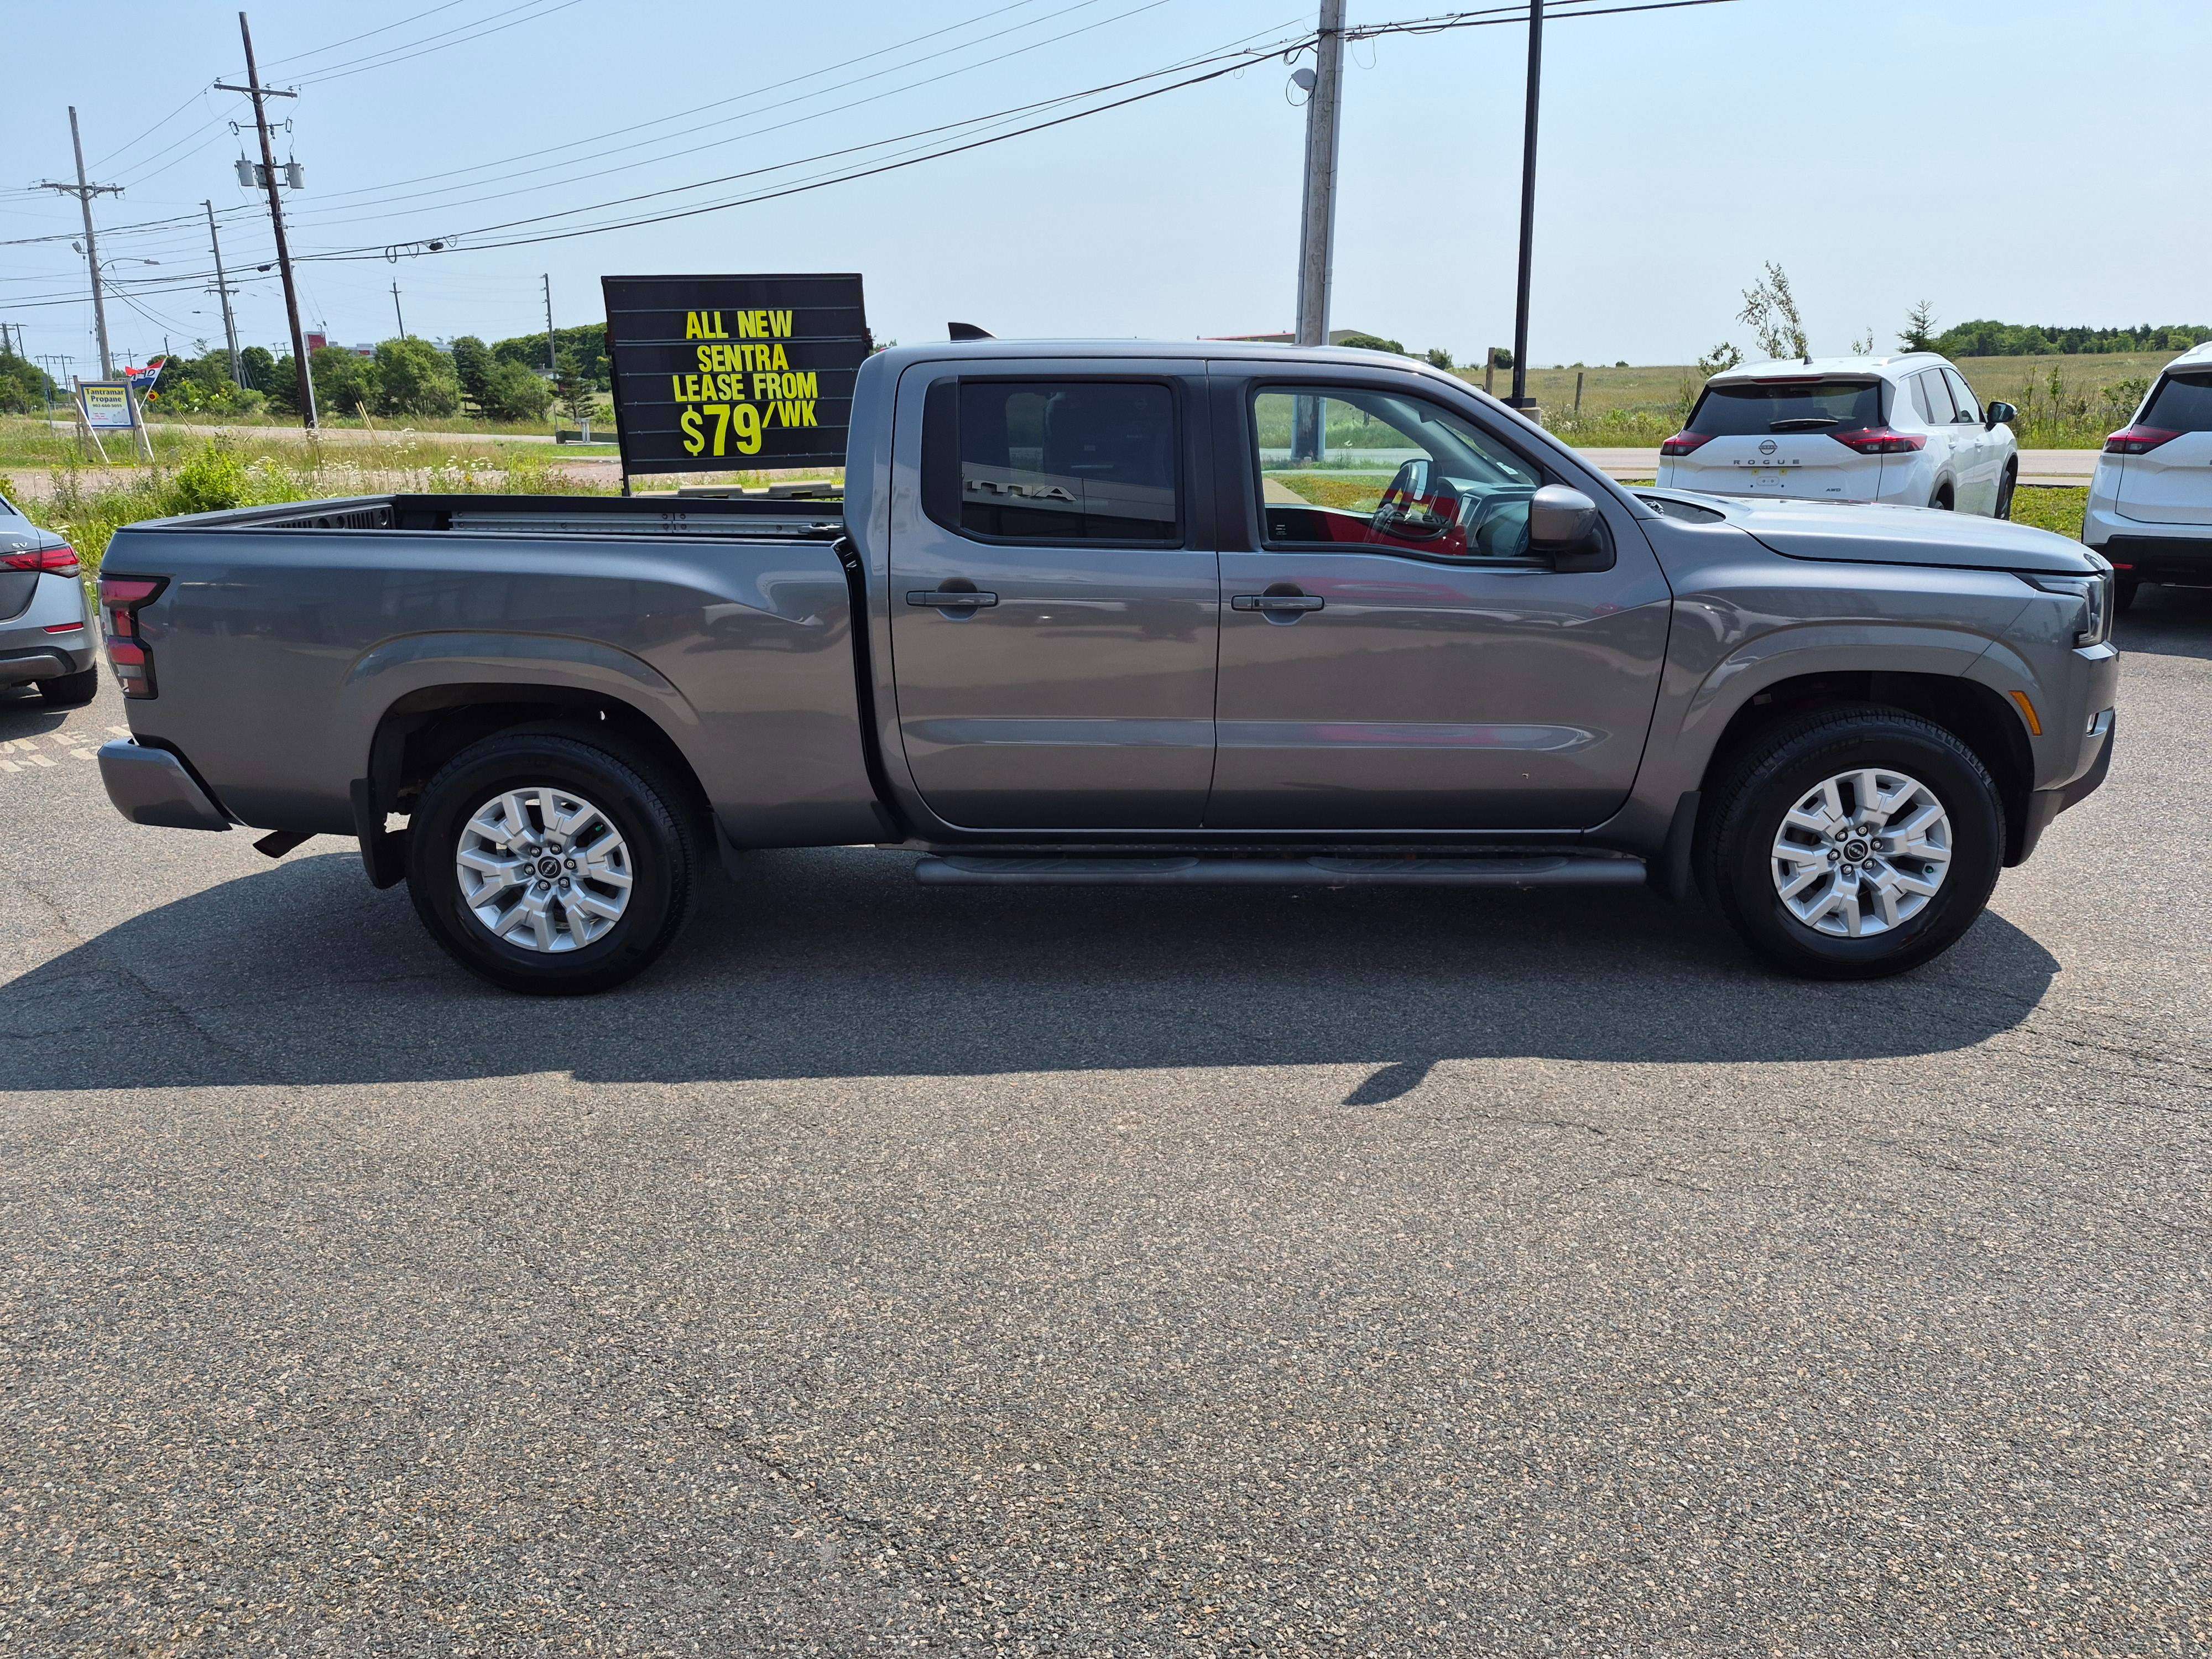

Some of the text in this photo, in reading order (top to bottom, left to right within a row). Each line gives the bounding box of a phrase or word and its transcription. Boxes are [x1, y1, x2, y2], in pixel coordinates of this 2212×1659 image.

[686, 310, 792, 339] ALL NEW
[697, 344, 789, 372] SENTRA
[672, 372, 818, 402] LEASE FROM
